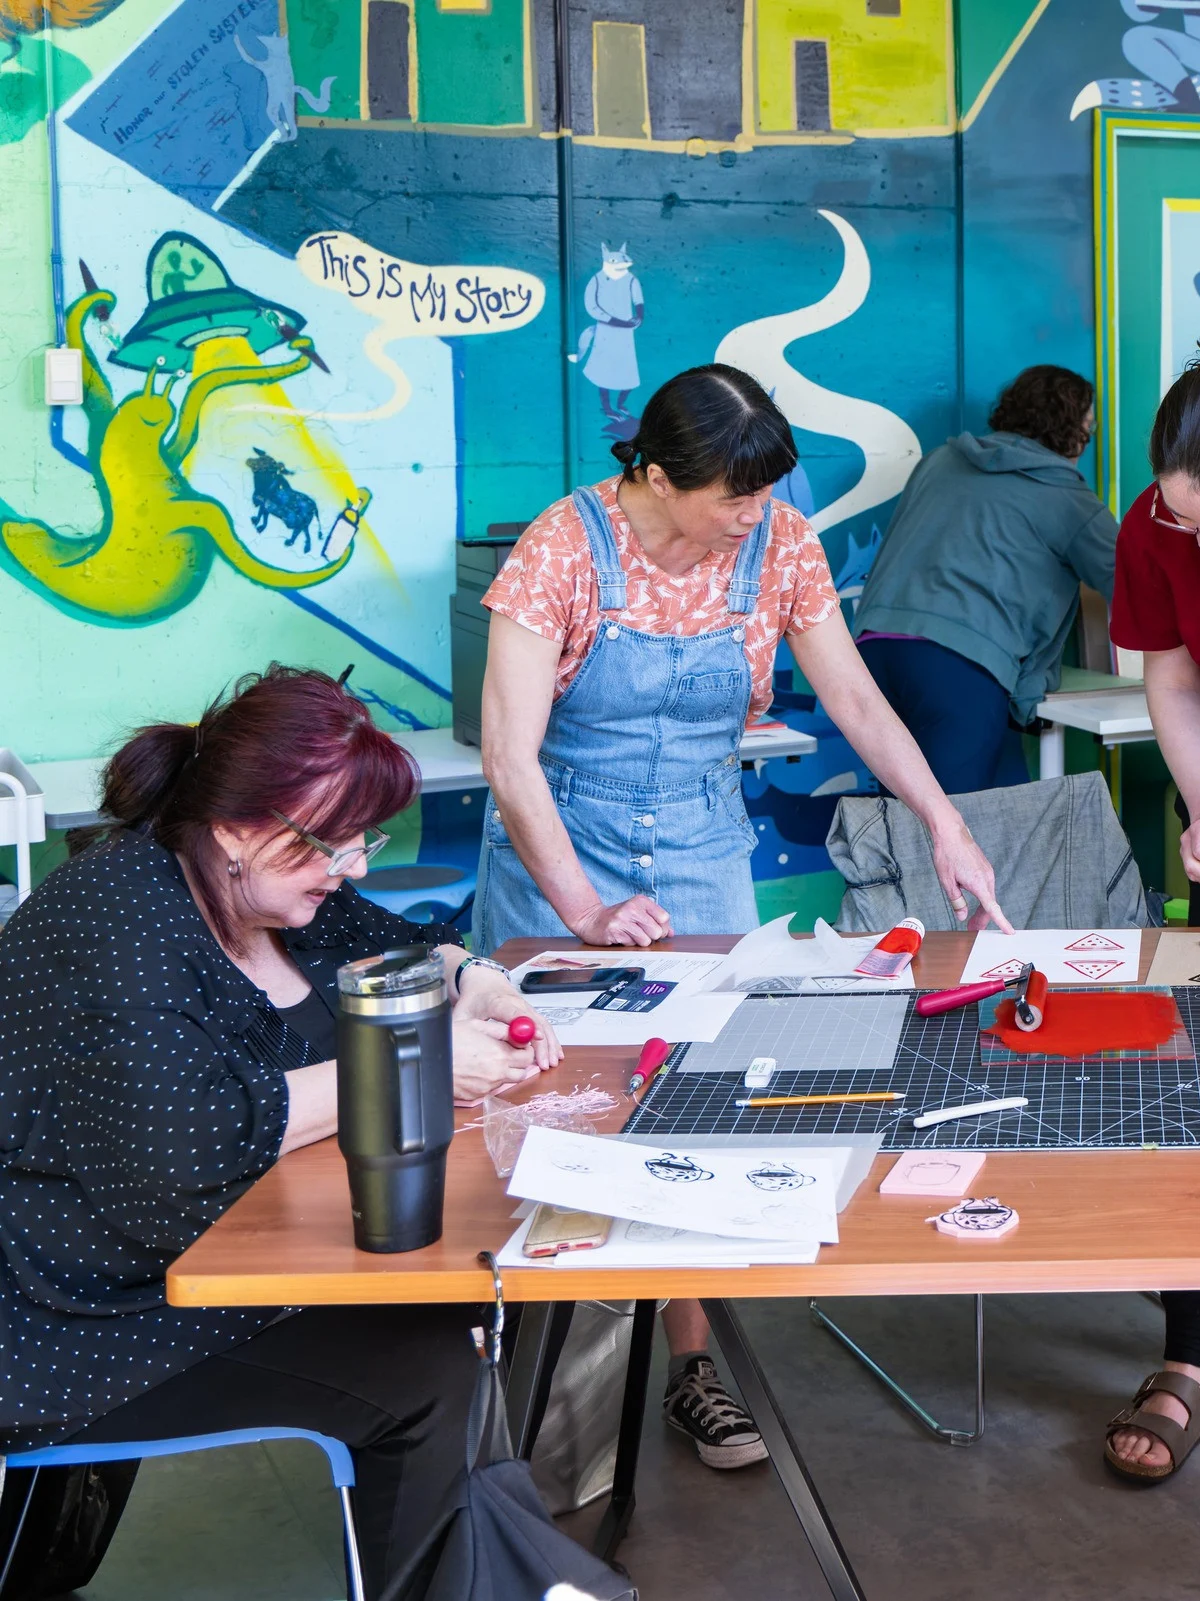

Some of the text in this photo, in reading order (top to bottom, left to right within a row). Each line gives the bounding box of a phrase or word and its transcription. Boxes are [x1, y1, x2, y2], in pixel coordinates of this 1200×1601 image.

[306, 235, 532, 324] This is My Story
